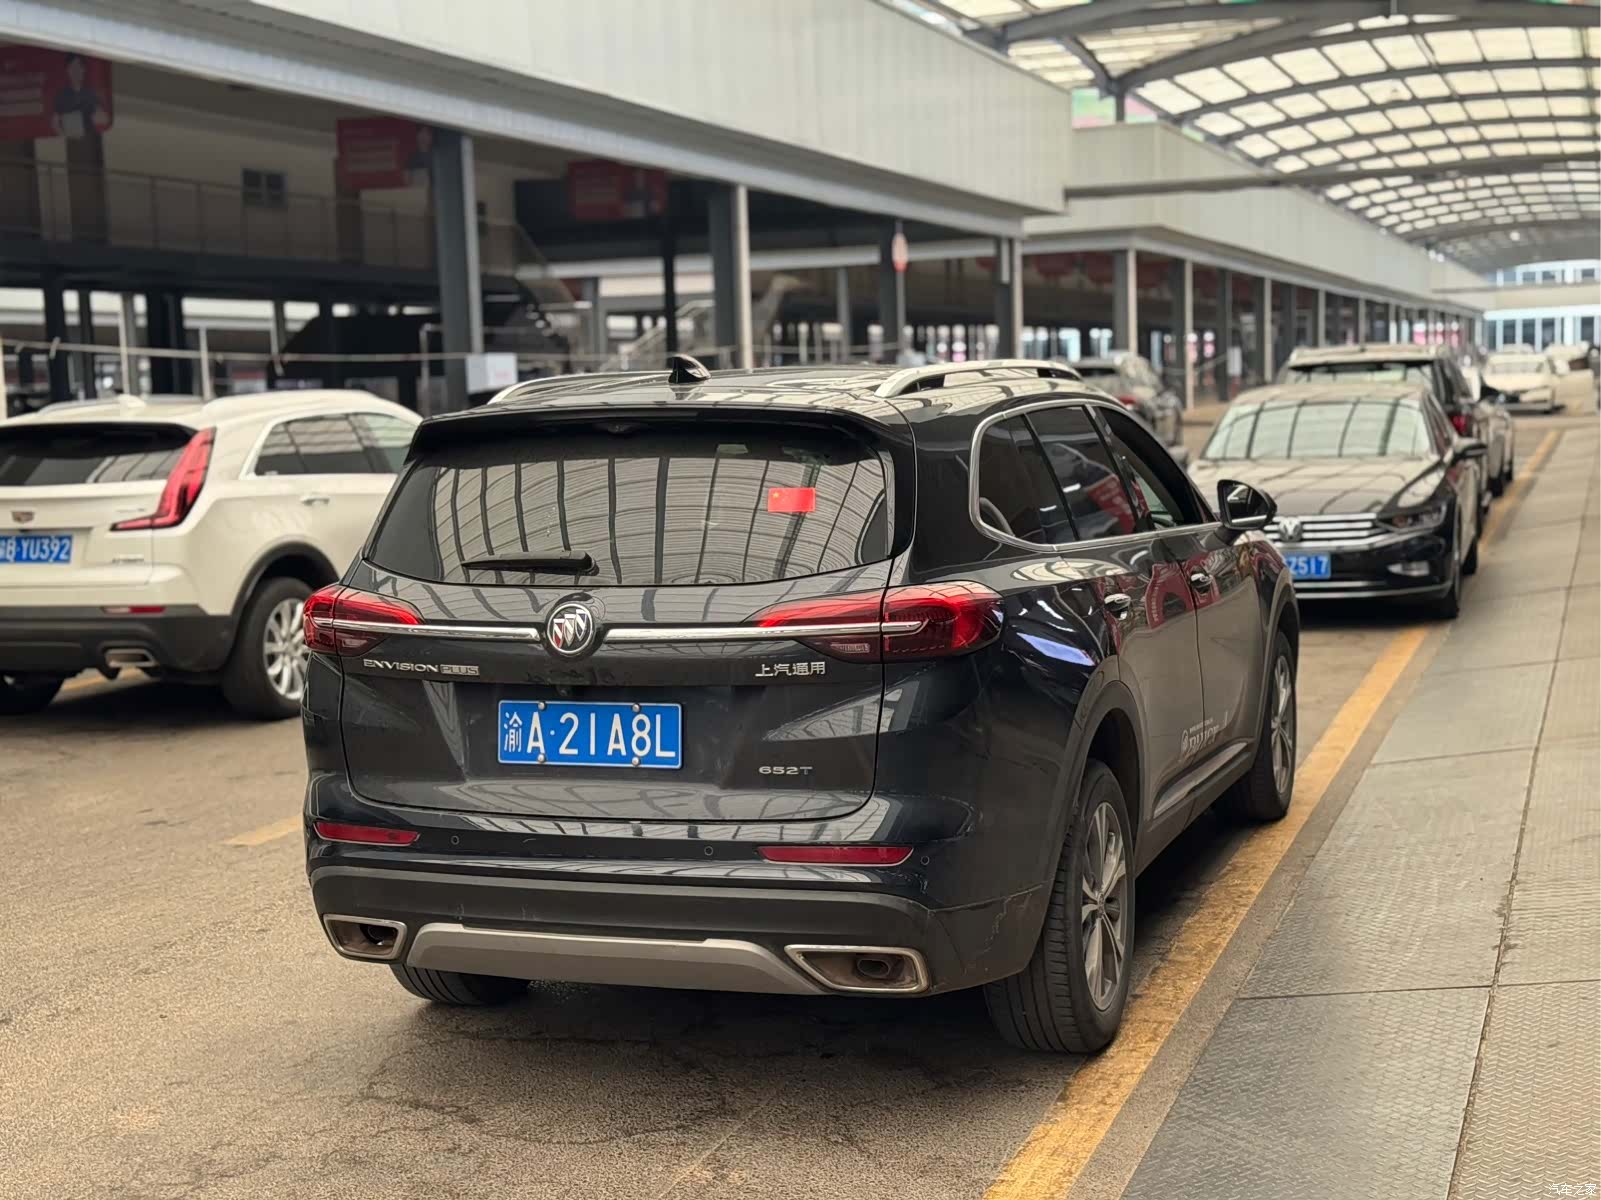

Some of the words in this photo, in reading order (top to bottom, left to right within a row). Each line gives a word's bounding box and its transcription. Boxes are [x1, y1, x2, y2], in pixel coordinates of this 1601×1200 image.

[363, 659, 439, 673] ENVISION
[440, 664, 480, 675] PLUS
[755, 661, 826, 677] 上汽通用
[503, 711, 676, 757] 渝A·21A8L
[758, 766, 813, 775] 652T
